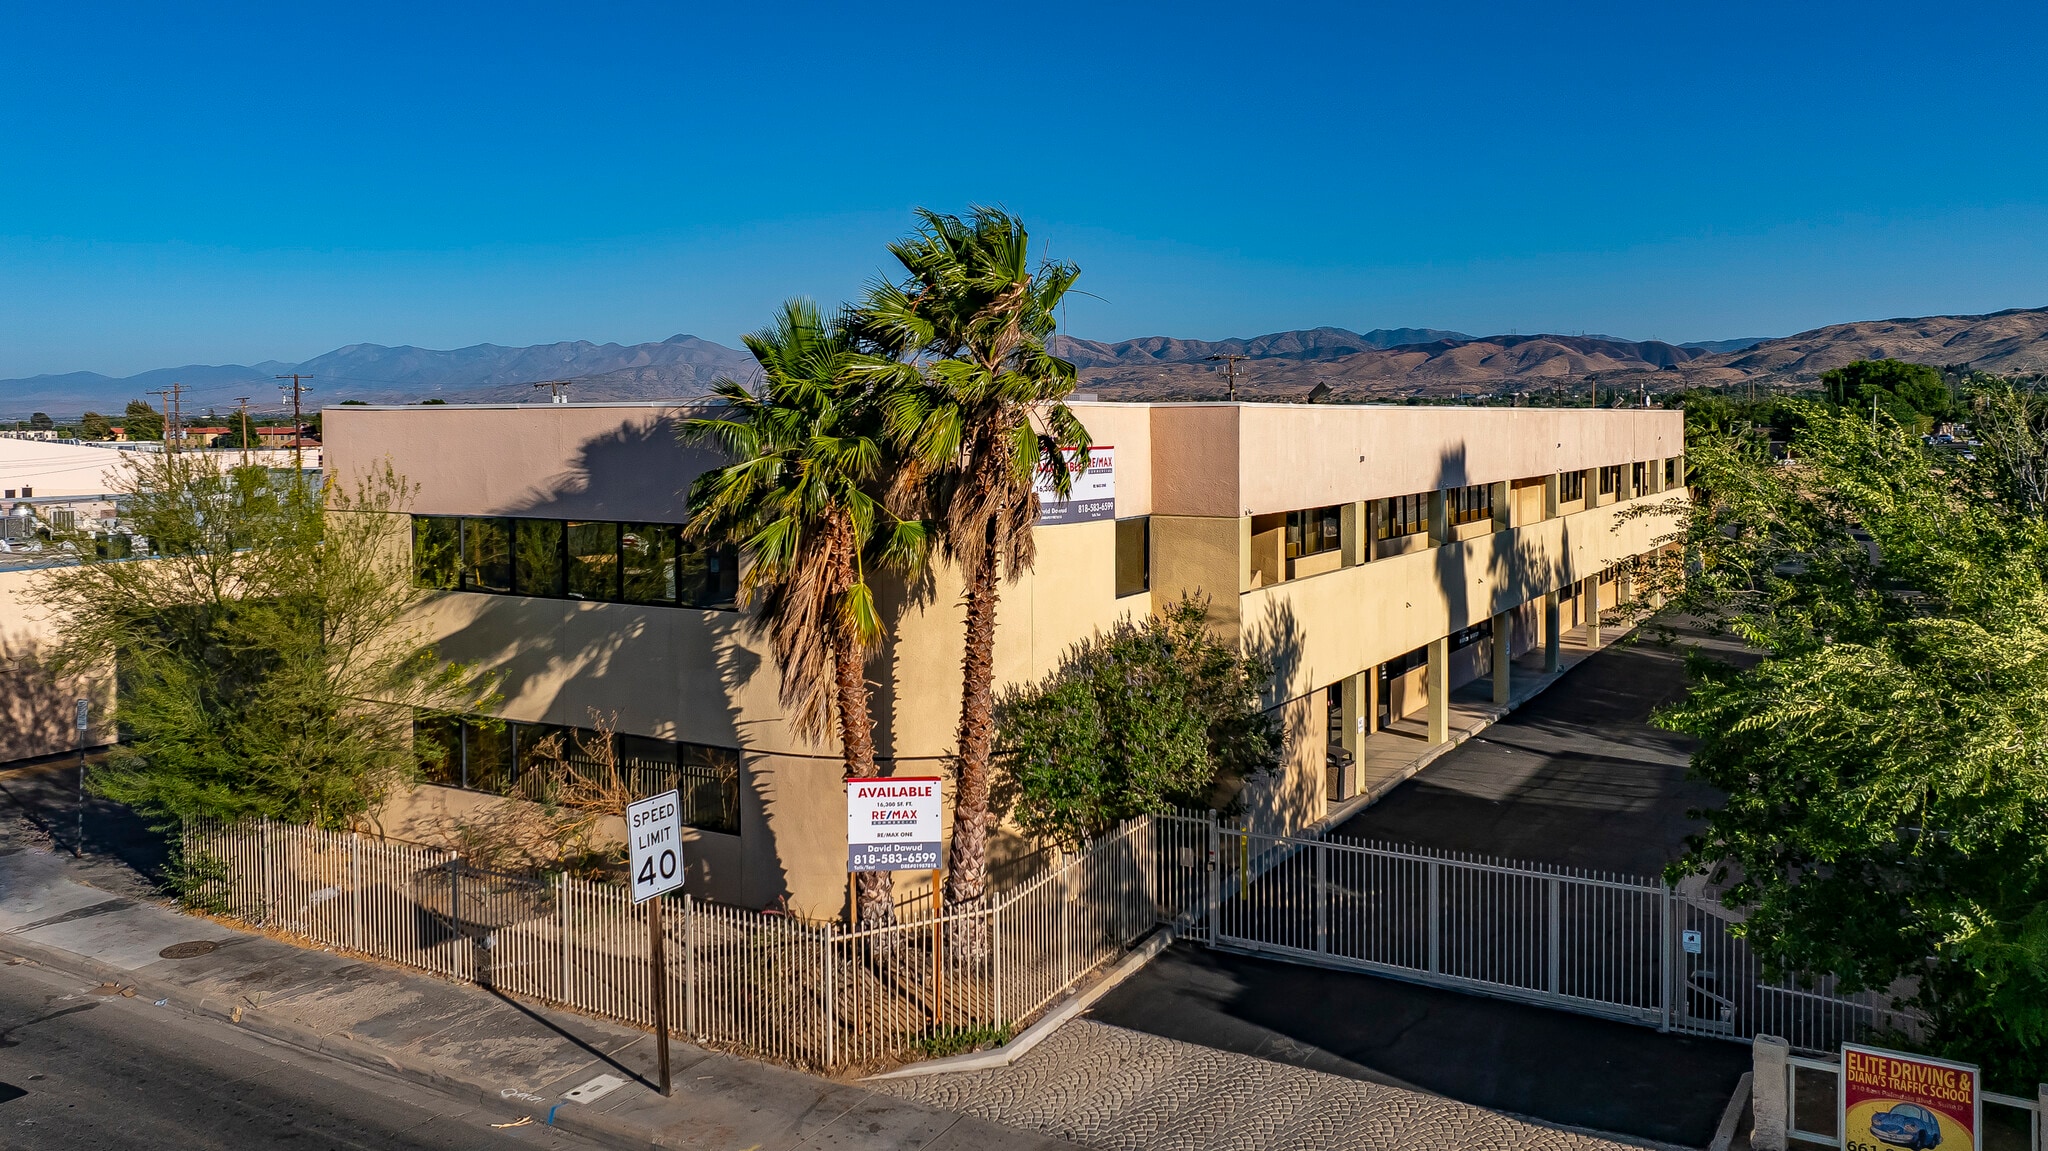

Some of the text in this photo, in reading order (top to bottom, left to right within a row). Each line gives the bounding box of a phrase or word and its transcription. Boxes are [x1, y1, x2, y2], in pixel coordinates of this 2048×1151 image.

[1088, 457, 1113, 468] RE/MAX
[1078, 502, 1114, 514] 818-583-6599
[858, 786, 932, 798] AVAILABLE
[633, 803, 675, 828] SPEED
[871, 810, 918, 820] RE/MAX
[638, 826, 671, 850] LIMIT
[867, 843, 923, 852] David Dawud
[854, 852, 937, 864] 818-583-6599
[637, 849, 677, 886] 40
[1848, 1053, 1971, 1092] ELITE DRIVING &
[1848, 1069, 1972, 1104] DIANA'S TRAFFIC SCHOOL
